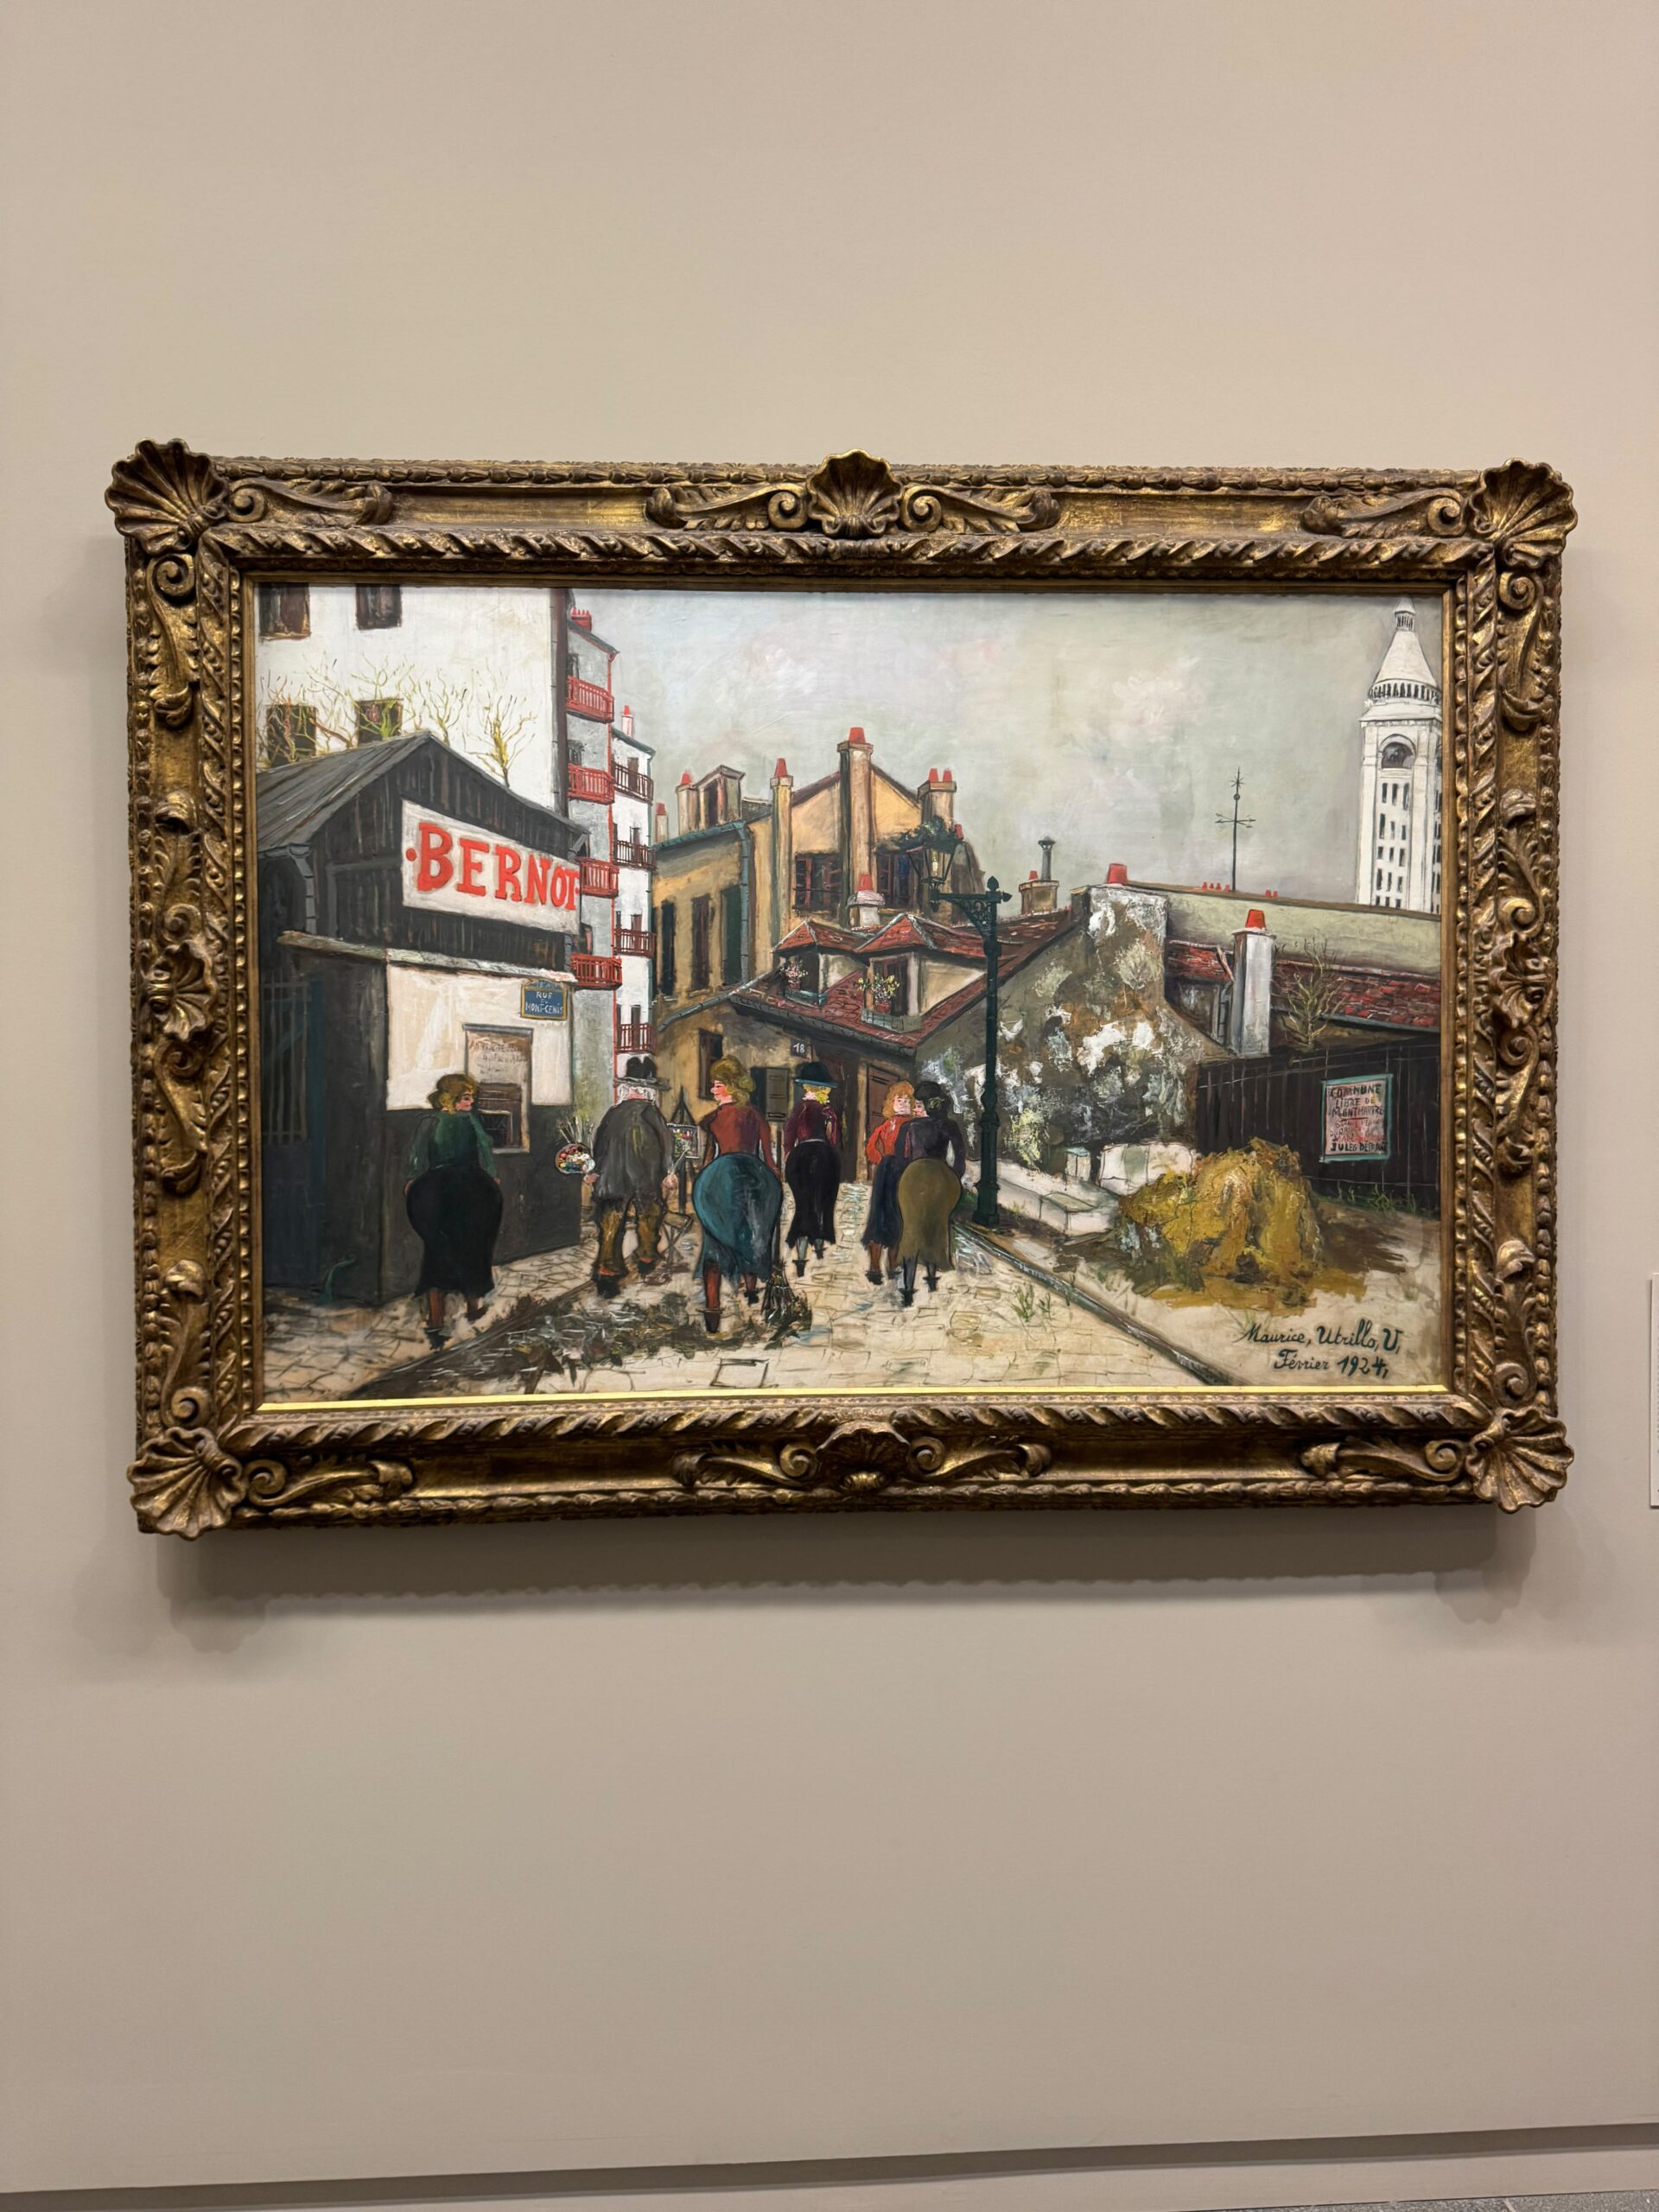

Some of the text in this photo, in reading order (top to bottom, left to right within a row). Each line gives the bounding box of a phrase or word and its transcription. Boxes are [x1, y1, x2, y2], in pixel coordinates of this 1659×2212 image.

[536, 991, 553, 1000] RUE
[792, 1042, 805, 1053] 18
[1331, 1084, 1382, 1098] COMMUNE
[1335, 1097, 1361, 1108] LIBRE
[1331, 1142, 1357, 1152] JULES
